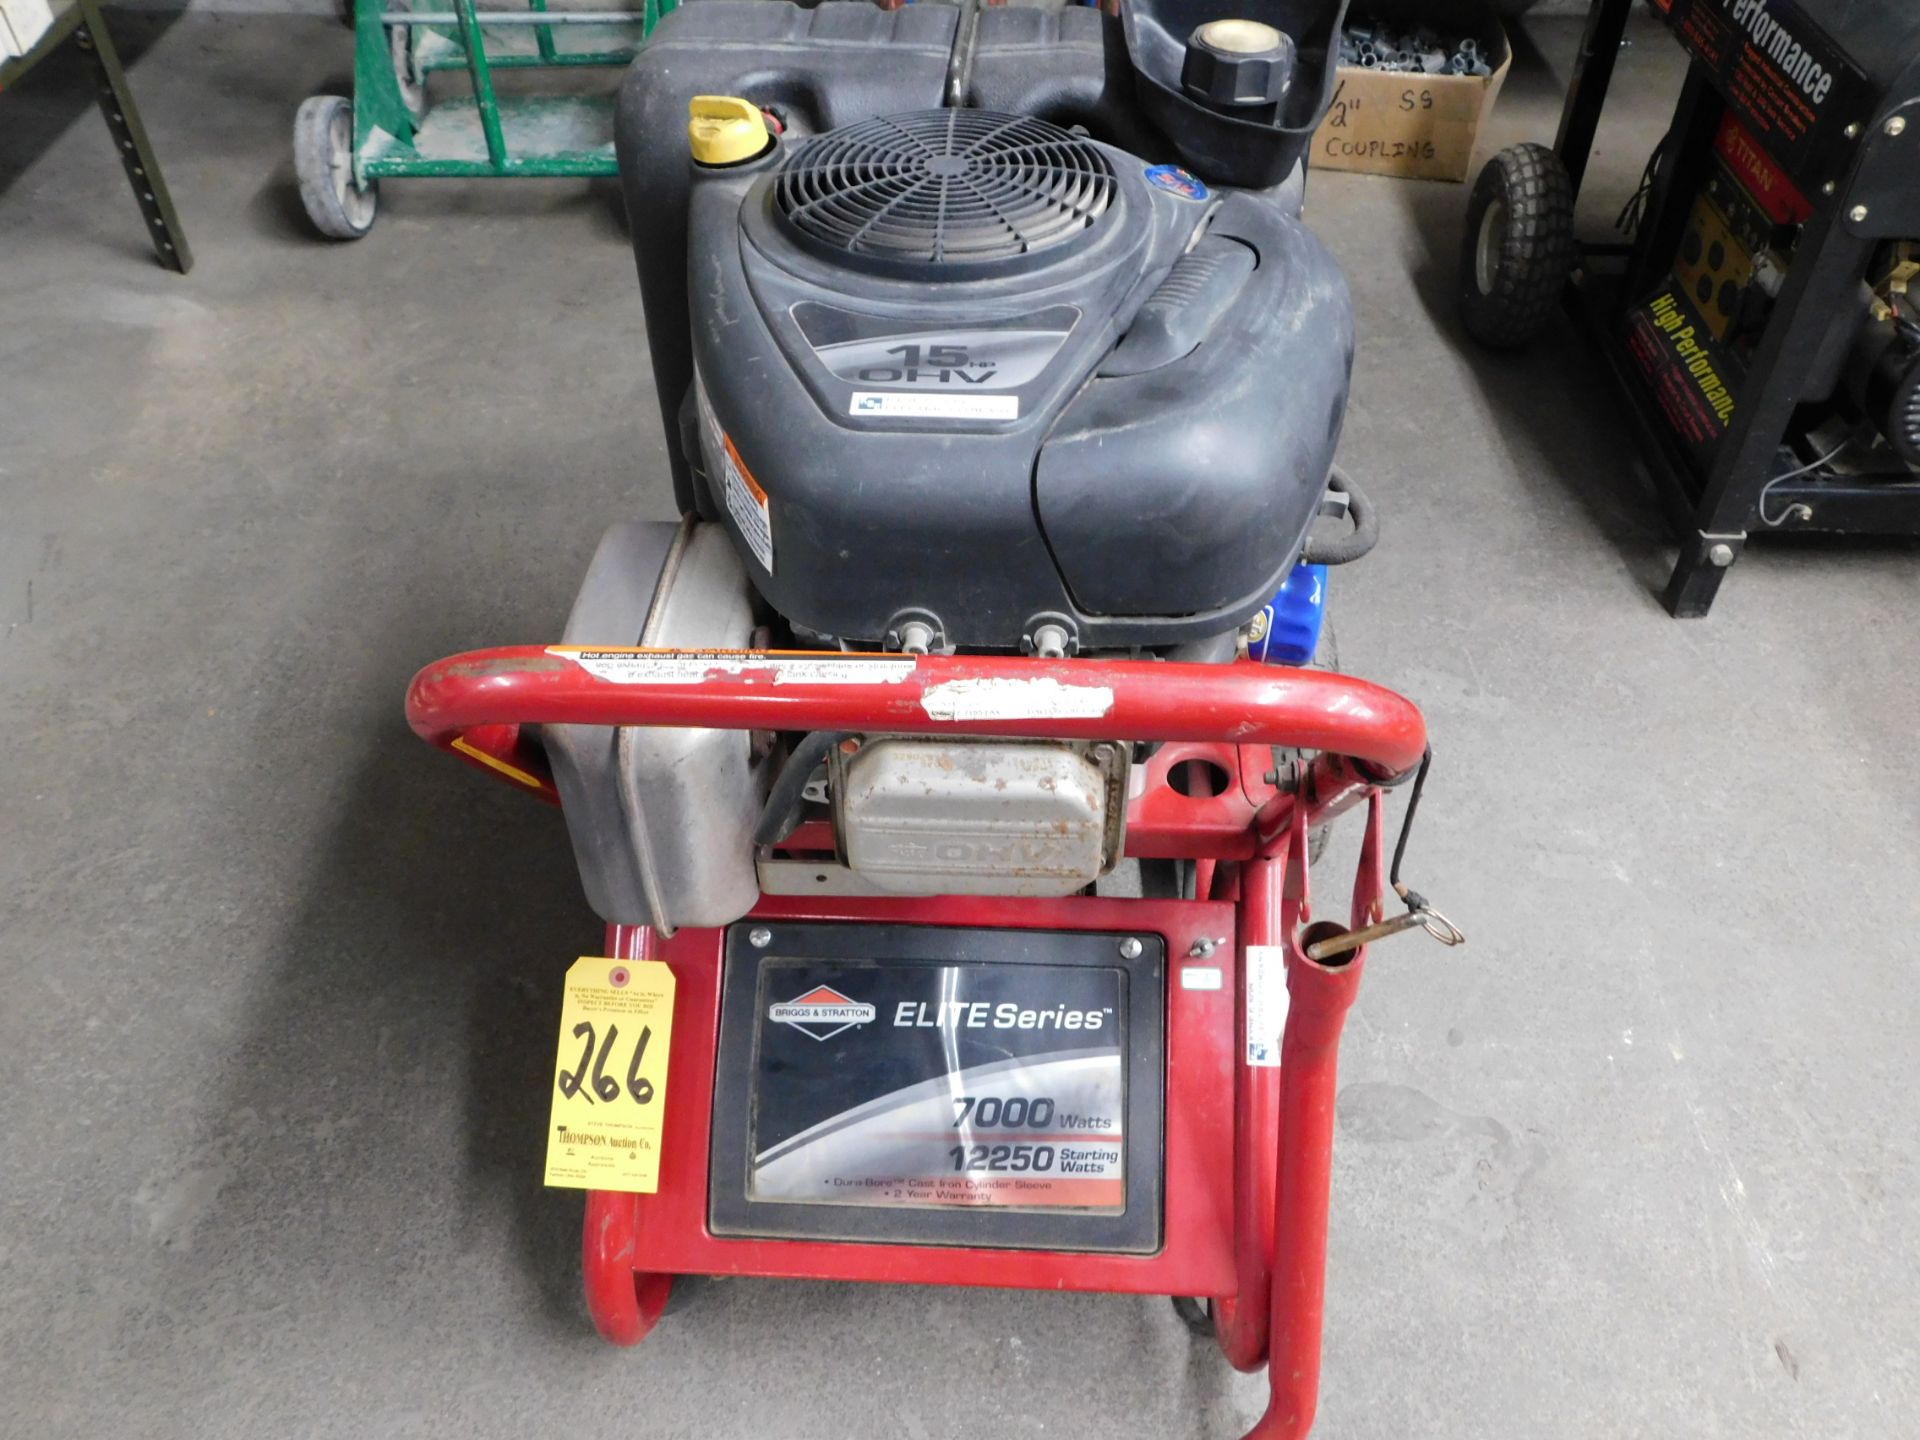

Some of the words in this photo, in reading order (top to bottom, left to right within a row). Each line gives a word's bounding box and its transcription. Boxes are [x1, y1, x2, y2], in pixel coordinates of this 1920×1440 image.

[1722, 0, 1832, 104] erformance
[1326, 137, 1436, 159] COUPLING
[1737, 137, 1776, 192] TITAN
[1649, 293, 1685, 332] High
[886, 345, 969, 367] 15
[858, 368, 998, 383] OHV
[677, 653, 695, 661] gas
[775, 1007, 811, 1017] BRIGGS
[813, 1008, 820, 1017] &
[822, 1008, 870, 1017] STRATTON
[893, 1001, 990, 1028] ELITE
[558, 1021, 654, 1105] 266
[952, 1097, 1055, 1129] 7000
[1060, 1114, 1112, 1129] Watts
[557, 1126, 607, 1146] THOMPSON
[609, 1137, 637, 1149] Auction
[949, 1145, 1055, 1172] 12250
[1060, 1148, 1118, 1164] Starting
[1061, 1162, 1104, 1173] Watts
[893, 1190, 902, 1198] 2
[906, 1190, 933, 1199] Year
[936, 1191, 992, 1201] Warranty
[908, 1179, 936, 1188] Cast
[939, 1179, 962, 1189] Iron
[965, 1180, 1012, 1191] Cylinder
[1014, 1181, 1052, 1190] Sleeve
